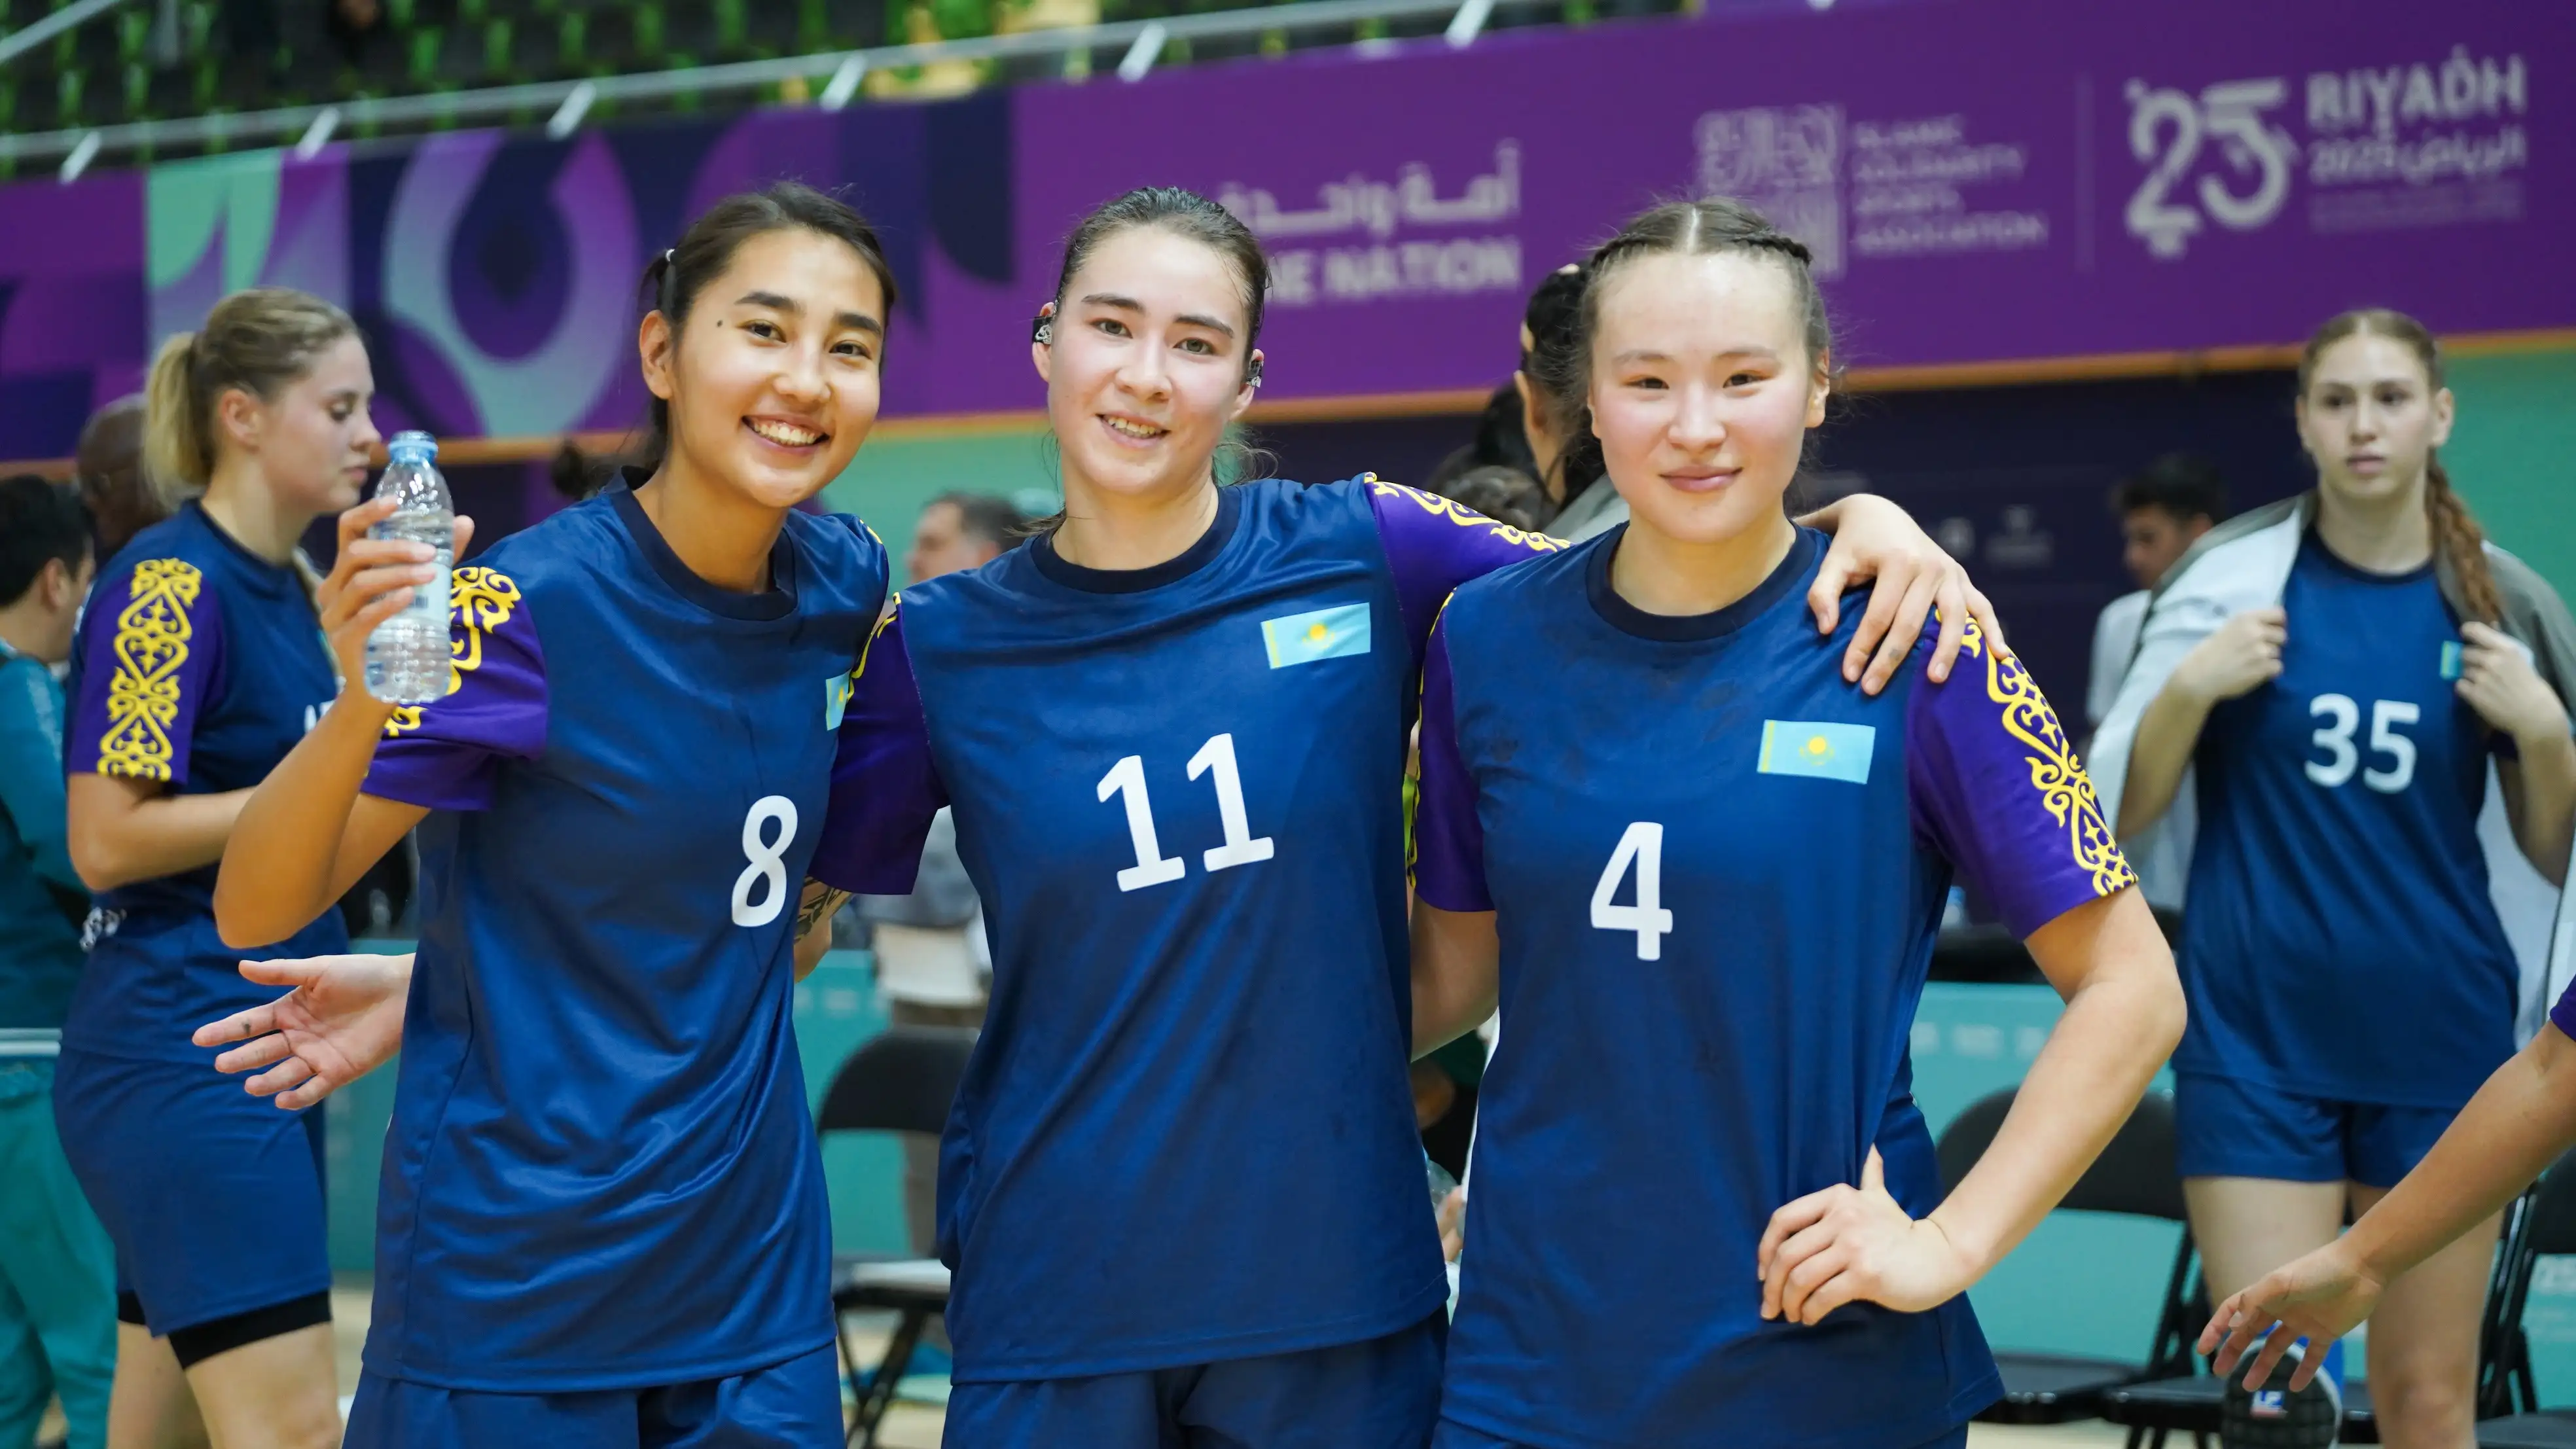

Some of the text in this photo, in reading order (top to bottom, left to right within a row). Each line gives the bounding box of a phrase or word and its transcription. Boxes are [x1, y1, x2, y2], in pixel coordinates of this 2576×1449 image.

[2307, 46, 2526, 137] RIYADH
[1325, 238, 1520, 297] NATION
[2304, 692, 2420, 794] 35
[732, 795, 798, 927] 8
[1096, 732, 1274, 892] 11
[1590, 821, 1673, 961] 4
